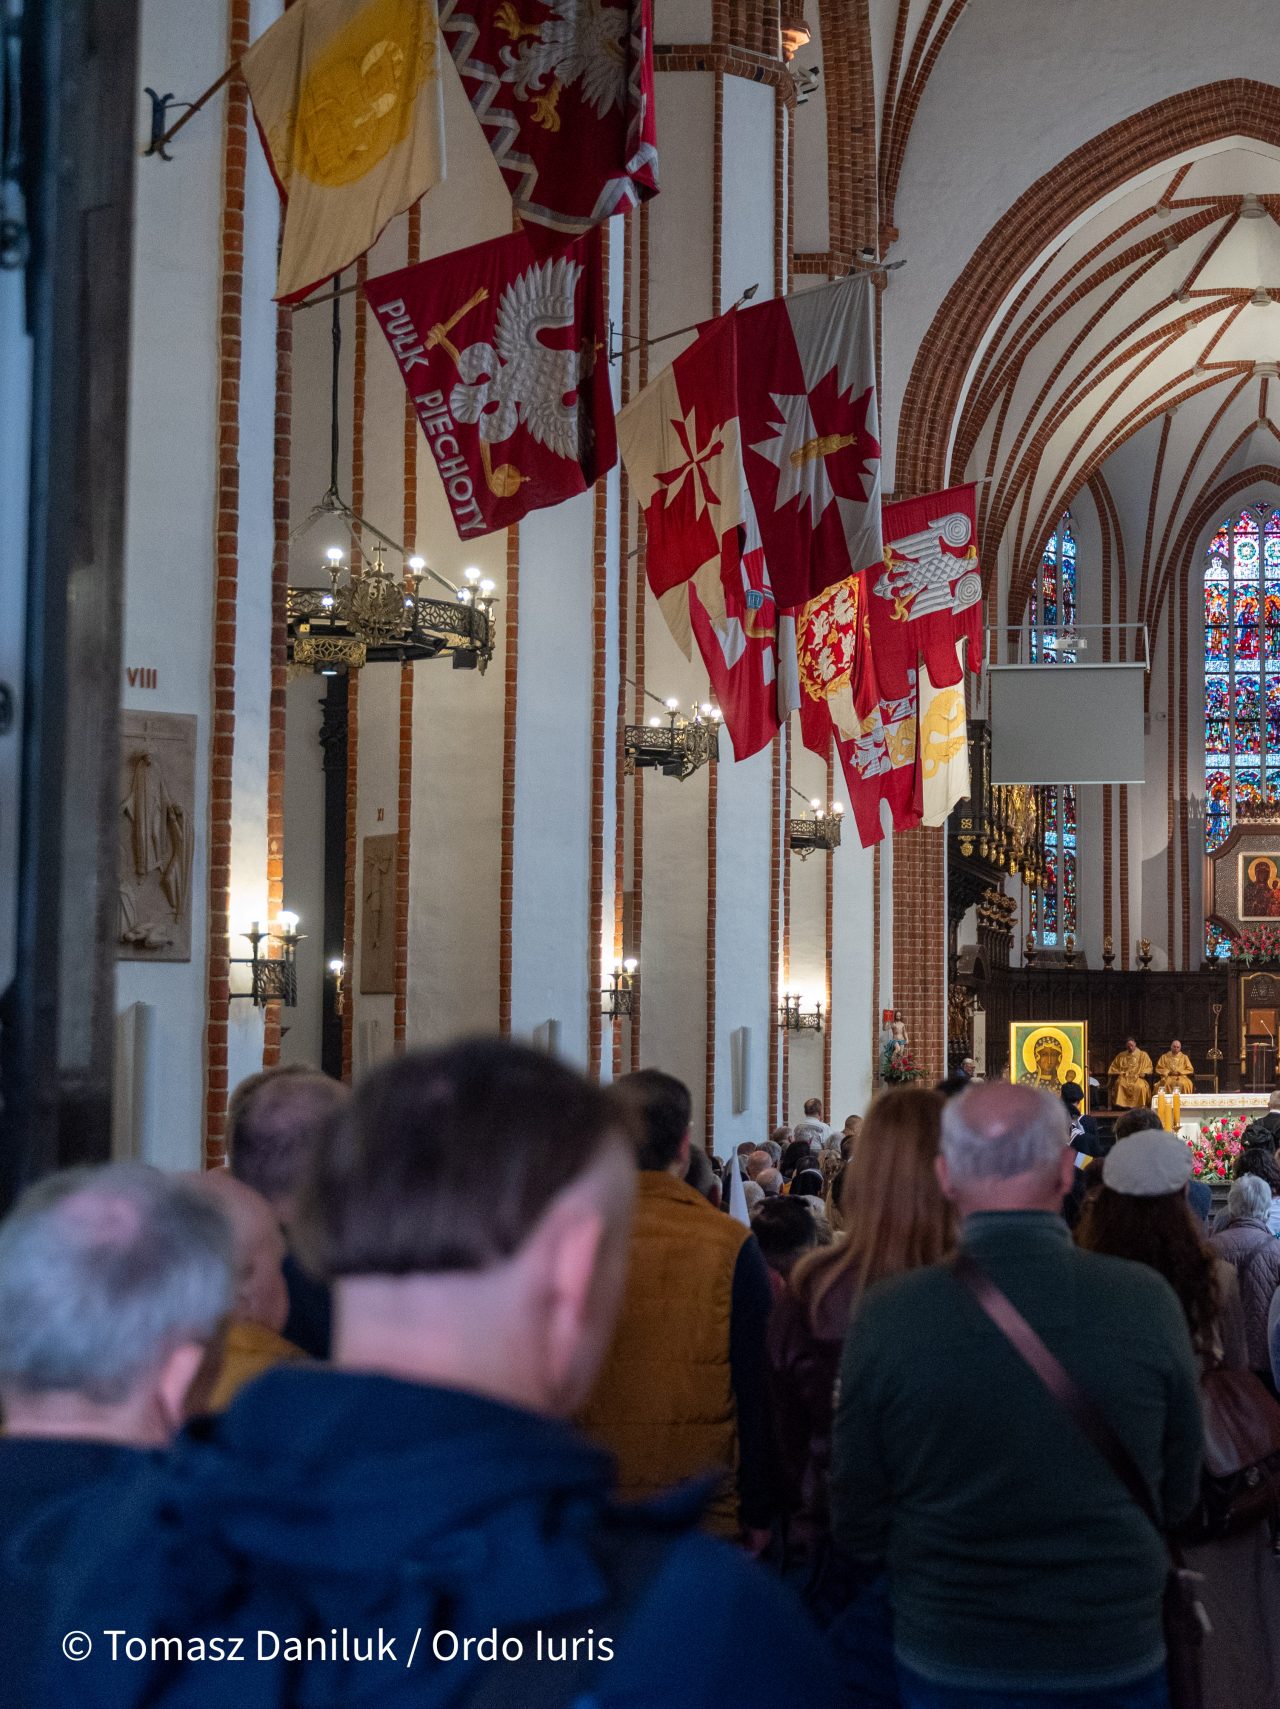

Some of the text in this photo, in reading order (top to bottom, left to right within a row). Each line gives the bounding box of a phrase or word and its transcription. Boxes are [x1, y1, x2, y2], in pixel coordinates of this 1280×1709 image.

[377, 297, 488, 531] PUŁK PIECHOTY
[126, 666, 158, 689] VIII
